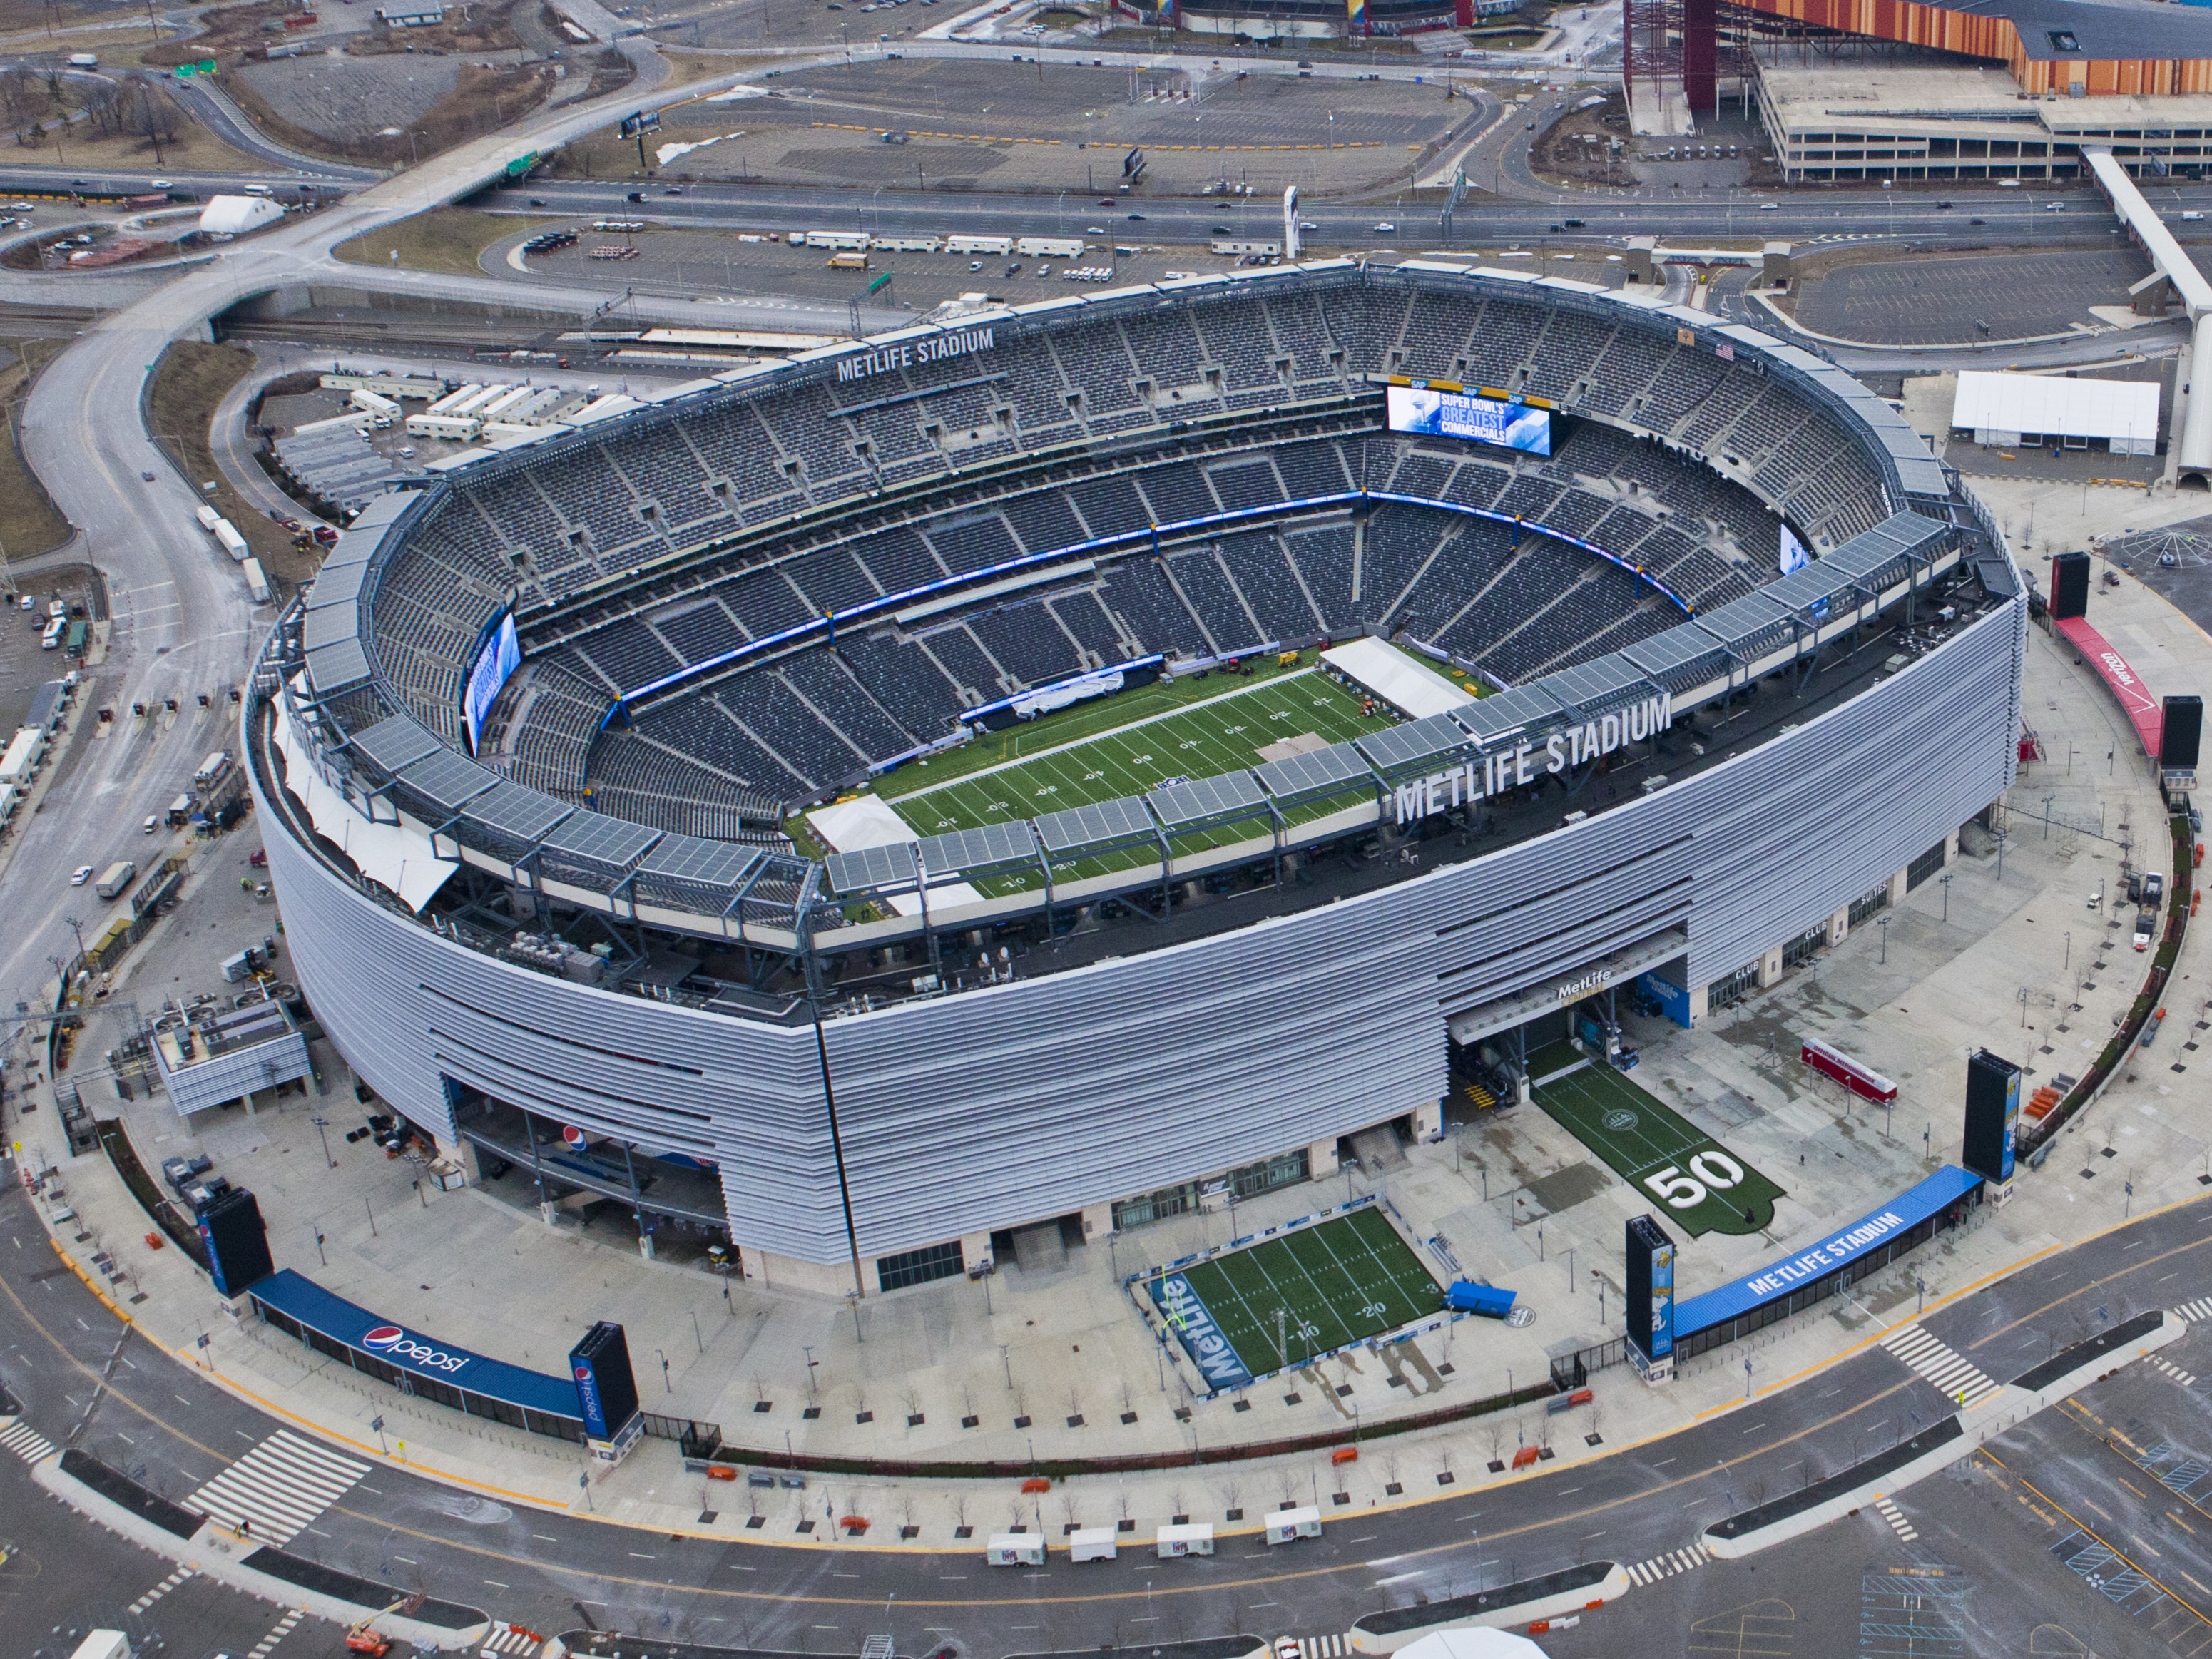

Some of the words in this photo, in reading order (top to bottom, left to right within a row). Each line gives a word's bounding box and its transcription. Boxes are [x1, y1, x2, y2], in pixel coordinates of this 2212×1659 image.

[837, 346, 912, 382] METLIFE
[917, 328, 994, 363] STADIUM
[1411, 380, 1427, 389] SAP
[1462, 387, 1477, 396] SAP
[1441, 394, 1470, 409] SUPER
[1472, 397, 1505, 415] BOWL'S
[1509, 394, 1522, 404] SAP
[1441, 405, 1505, 429] GREATEST
[1441, 422, 1506, 442] COMMERCIALS
[2100, 653, 2135, 685] verizon
[1133, 755, 1153, 765] 50
[1395, 744, 1534, 825] METLIFE
[1546, 693, 1671, 774] STADIUM
[1861, 882, 1888, 905] SUITES
[1805, 921, 1828, 940] CLUB
[1736, 961, 1759, 980] CLUB
[1559, 969, 1611, 999] MetLife
[1813, 1045, 1838, 1063] OFFICIAL
[1643, 1150, 1744, 1208] 50
[1748, 1250, 1833, 1295] METLIFE
[1825, 1212, 1904, 1257] STADIUM
[1362, 1302, 1387, 1319] 20
[1159, 1279, 1244, 1380] MetLife
[1297, 1325, 1320, 1342] 10
[387, 1339, 470, 1372] pepsi
[581, 1386, 601, 1421] pepsi
